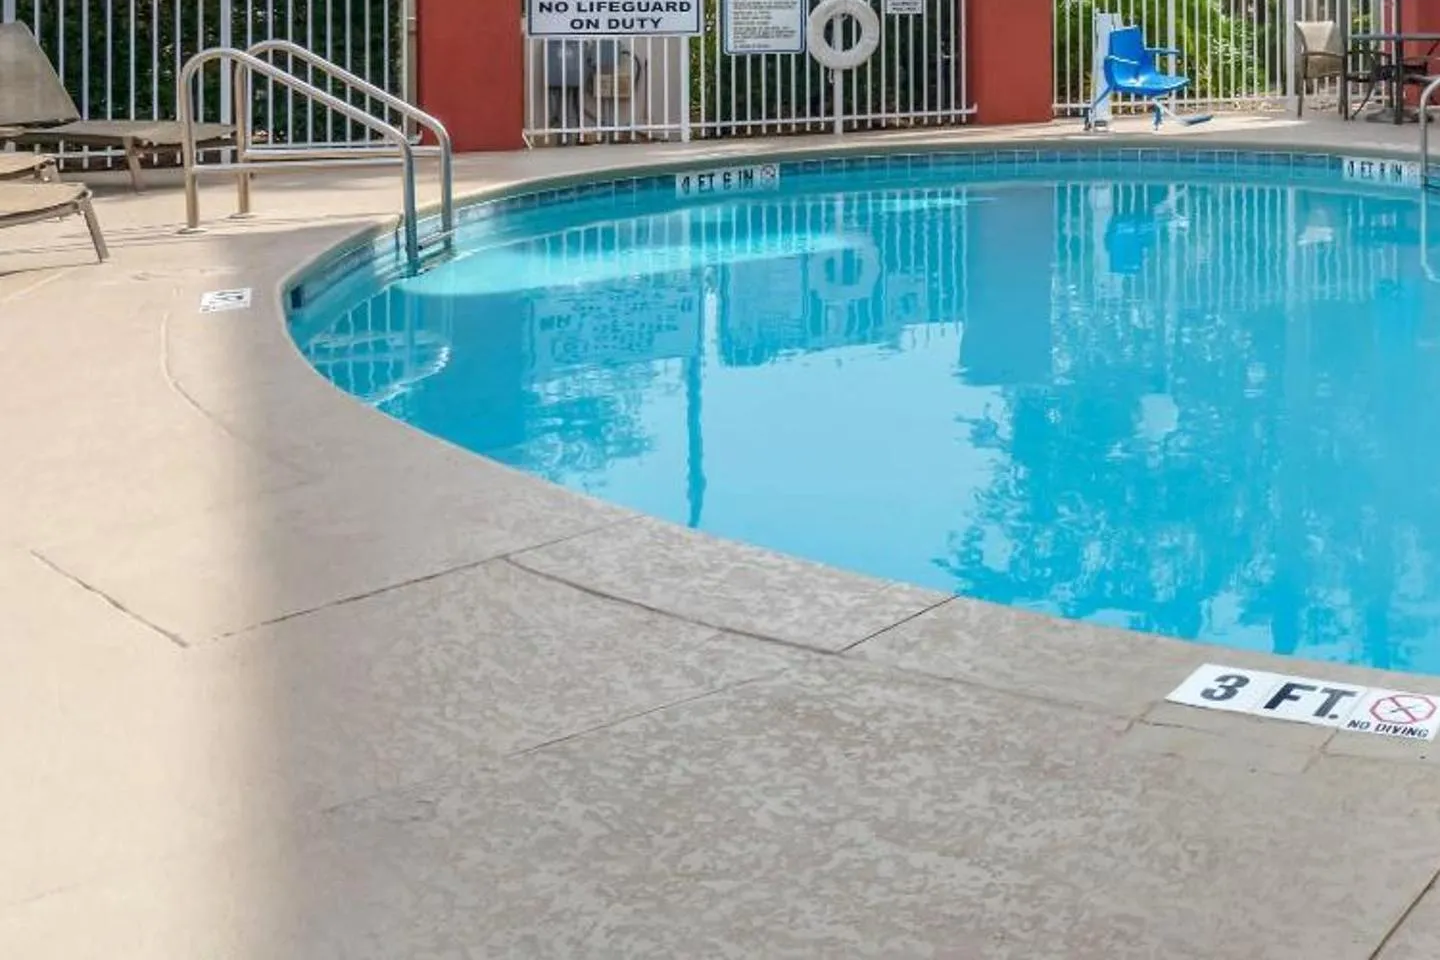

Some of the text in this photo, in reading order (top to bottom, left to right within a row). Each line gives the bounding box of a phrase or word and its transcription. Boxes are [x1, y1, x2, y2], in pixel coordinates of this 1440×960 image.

[538, 1, 692, 13] NO LIFEGUARD
[570, 17, 663, 30] ON DUTY
[1199, 673, 1358, 720] 3 FT.
[1346, 719, 1431, 739] NO DIVING
